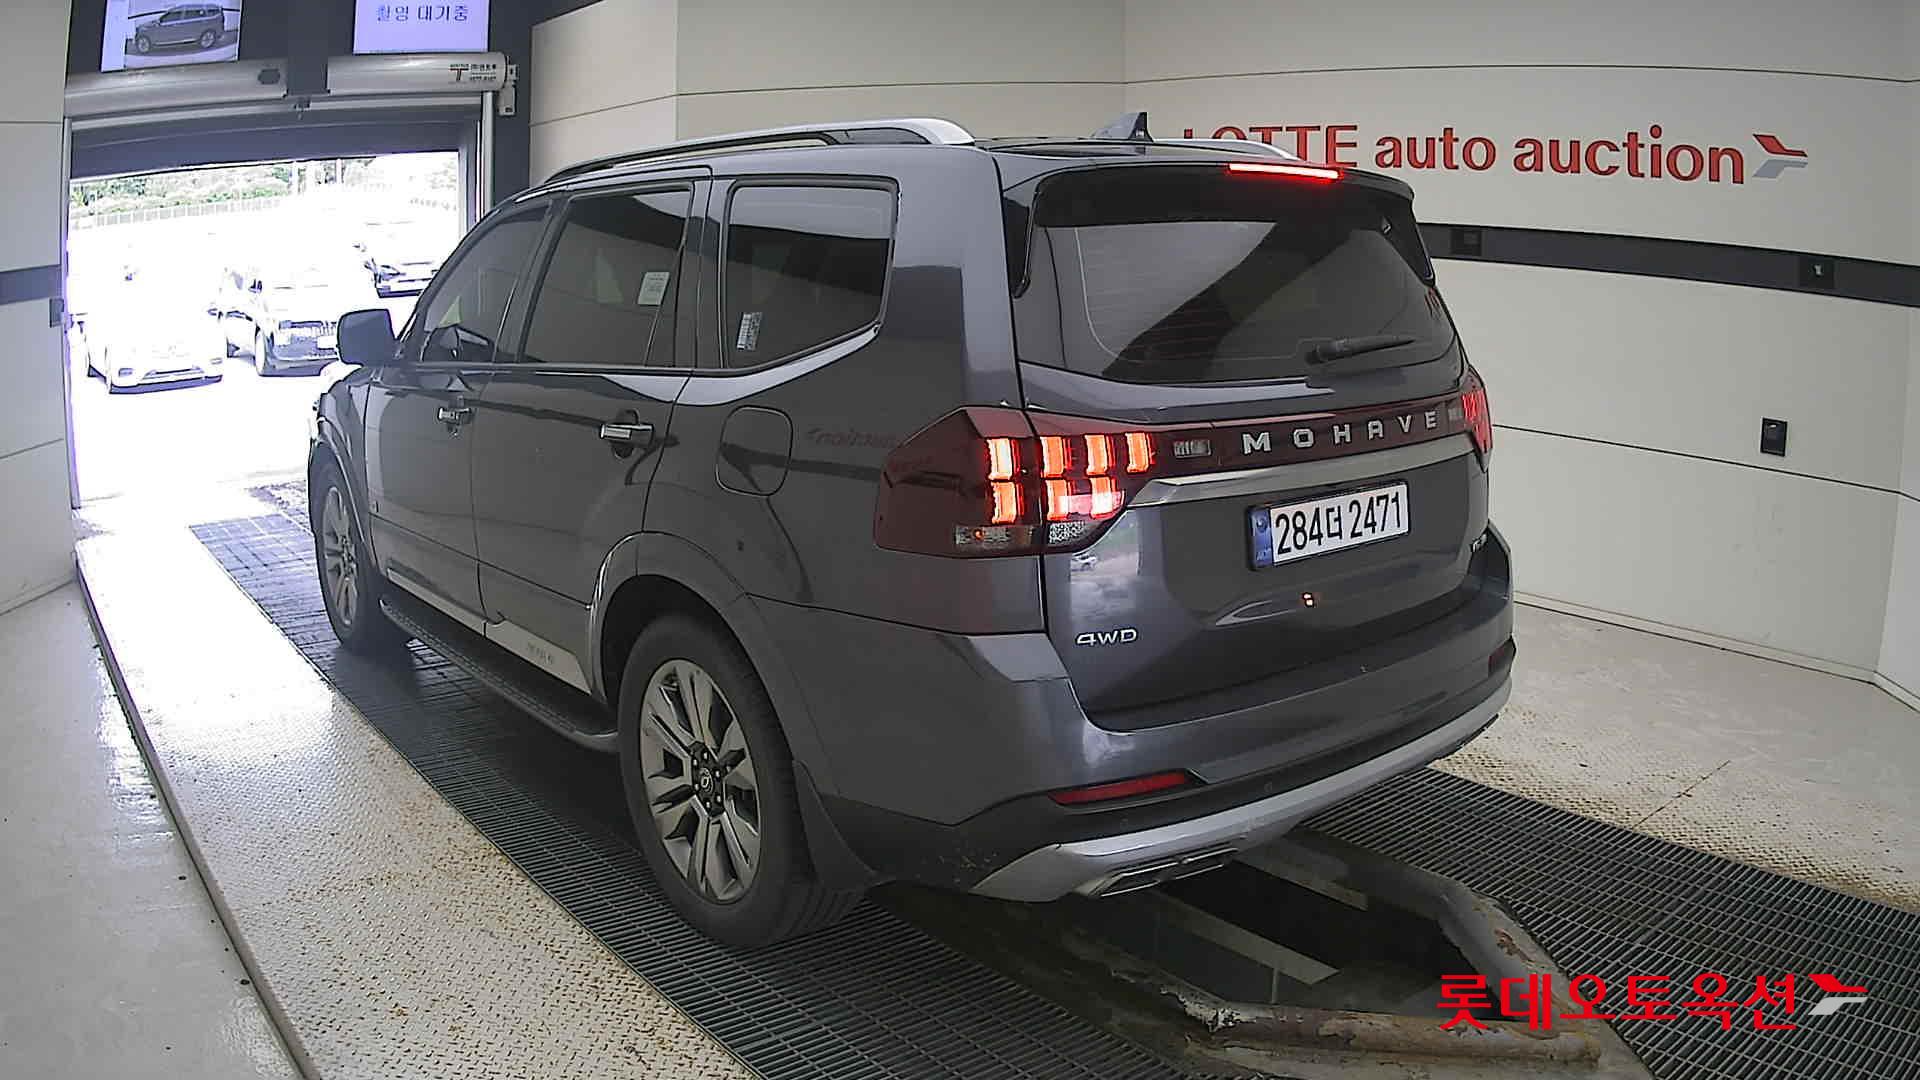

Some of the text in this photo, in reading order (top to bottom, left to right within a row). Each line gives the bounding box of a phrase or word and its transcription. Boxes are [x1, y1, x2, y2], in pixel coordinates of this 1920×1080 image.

[417, 5, 468, 21] 대기중
[1184, 124, 1744, 185] TTE auto auction
[1242, 410, 1438, 455] MOHAVE
[1275, 491, 1401, 555] 284더 2471
[1076, 628, 1138, 646] 4WD
